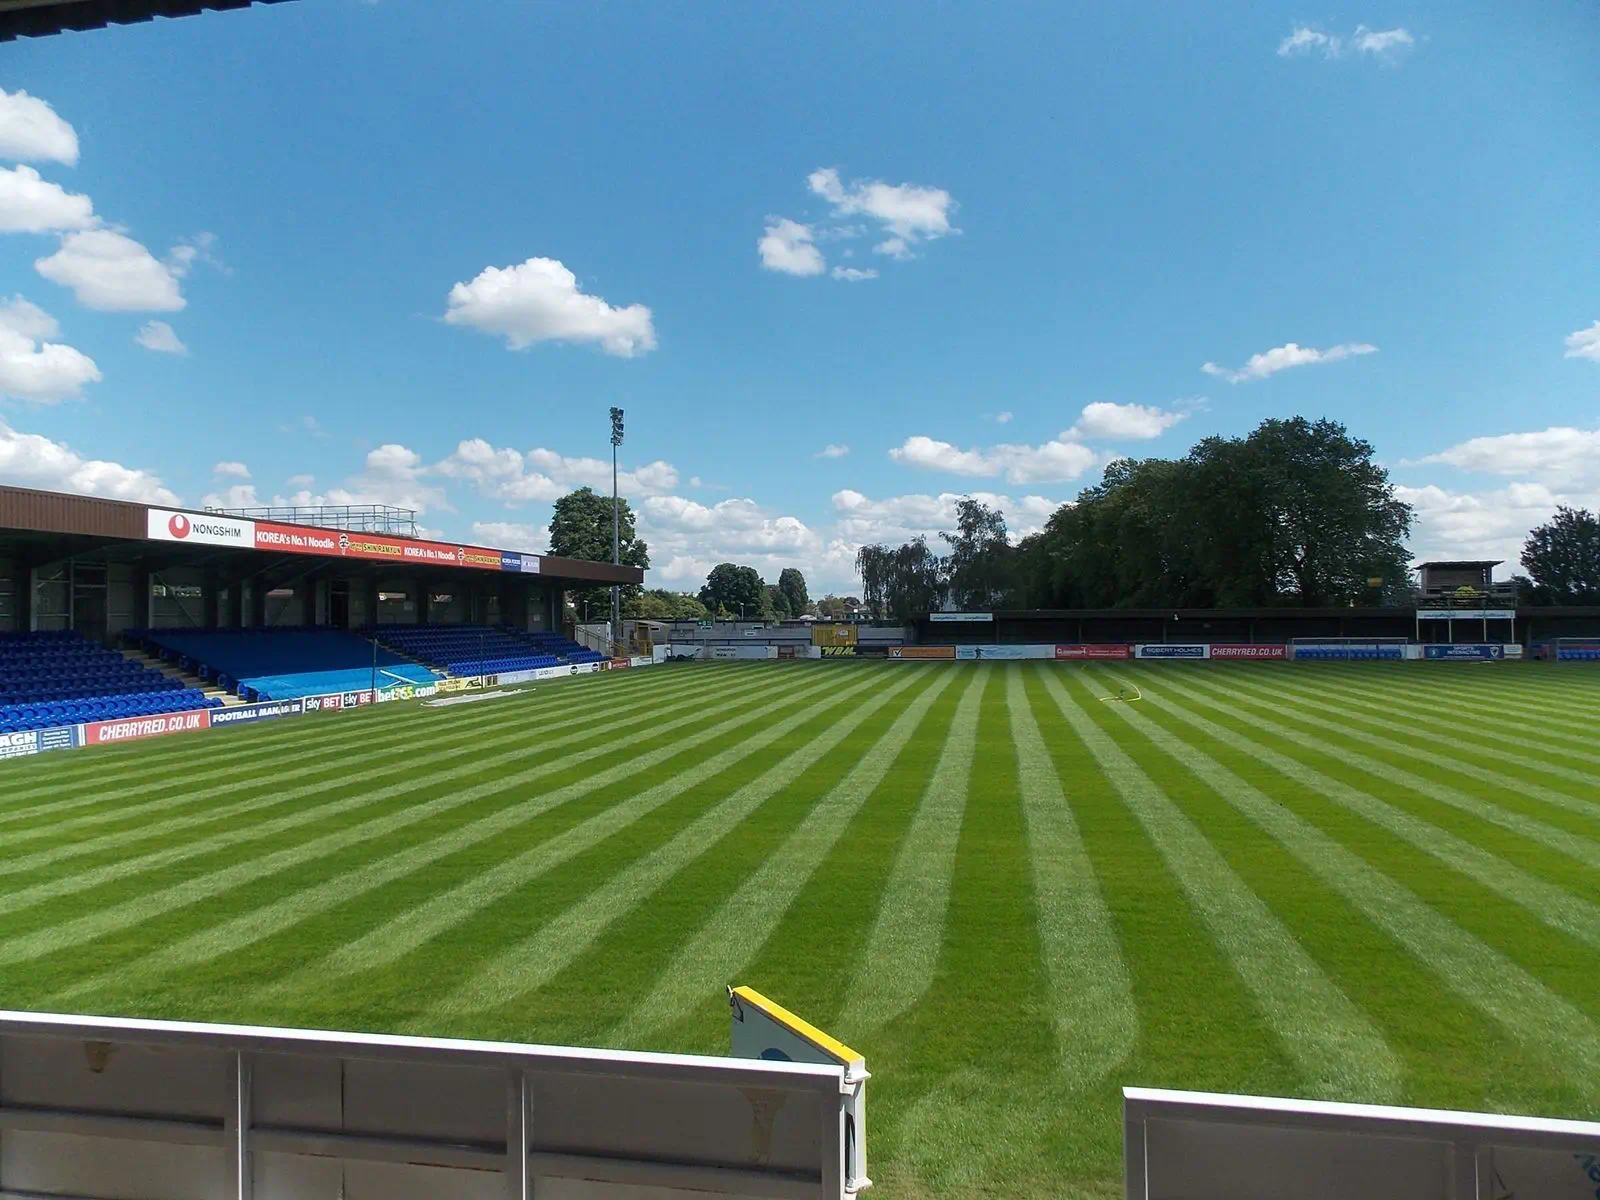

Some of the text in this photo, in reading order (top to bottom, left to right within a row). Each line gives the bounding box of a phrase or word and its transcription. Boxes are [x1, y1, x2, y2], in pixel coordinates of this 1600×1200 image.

[192, 523, 242, 538] NONGSHIM
[256, 531, 291, 545] KOREA's
[291, 536, 307, 547] No.1
[308, 537, 335, 549] Noodle
[437, 550, 456, 561] Noodle
[1211, 647, 1283, 656] CHERRYRED.CO.UK
[344, 693, 358, 706] sky
[377, 686, 436, 703] bet365.com
[306, 696, 341, 711] sky BET
[212, 709, 257, 723] FOOTBALL
[99, 713, 201, 742] CHERRYRED.CO.UK
